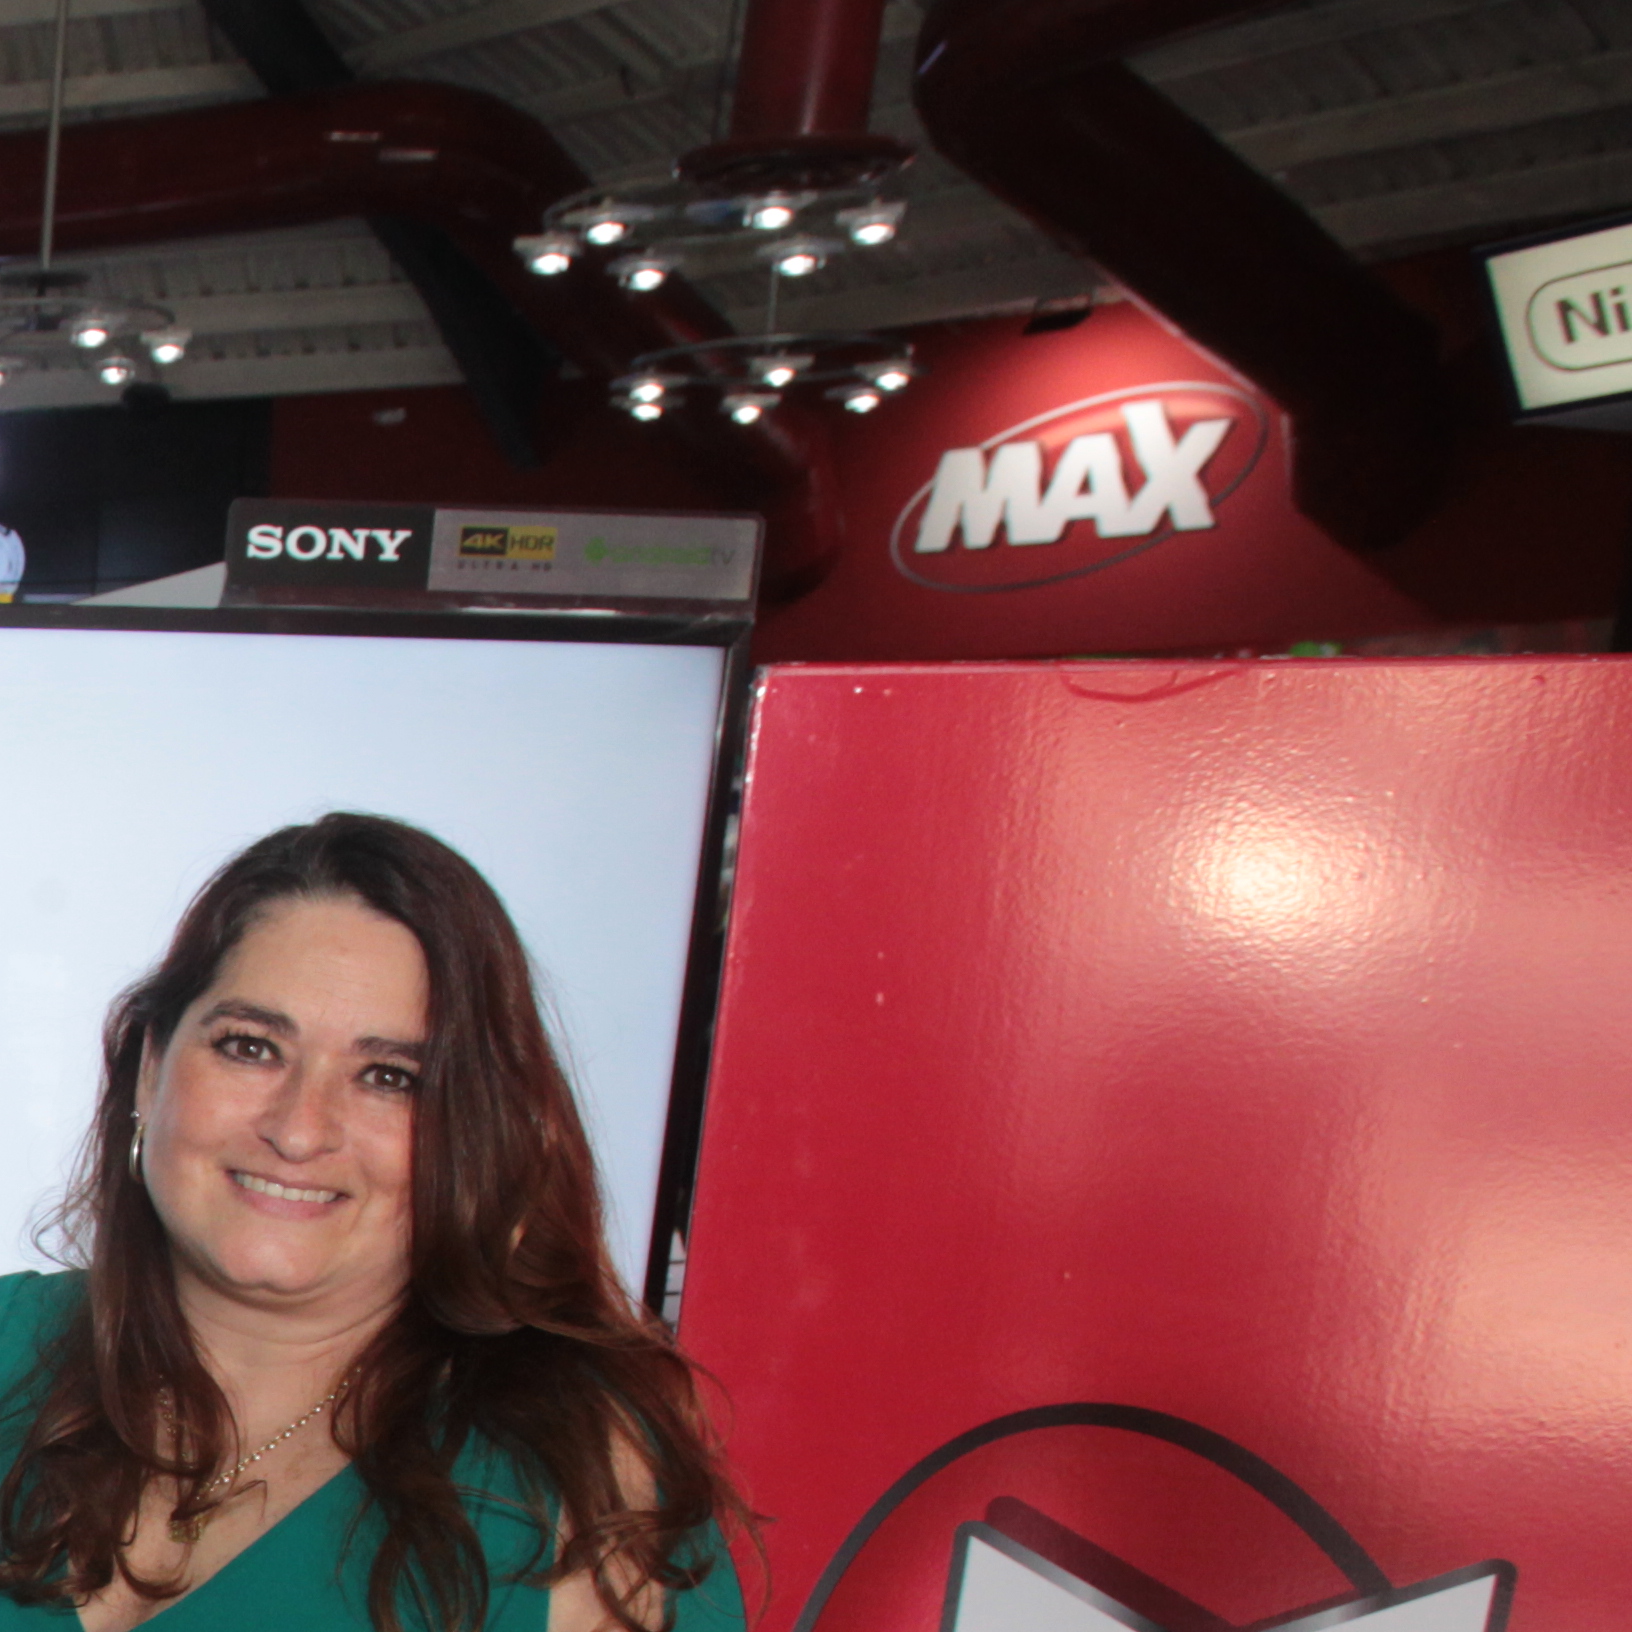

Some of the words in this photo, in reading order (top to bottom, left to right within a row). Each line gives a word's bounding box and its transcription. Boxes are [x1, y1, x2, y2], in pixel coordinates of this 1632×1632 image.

[914, 400, 1237, 556] MAX
[245, 525, 413, 563] SONY
[461, 531, 506, 549] 4K
[510, 534, 555, 552] HDR
